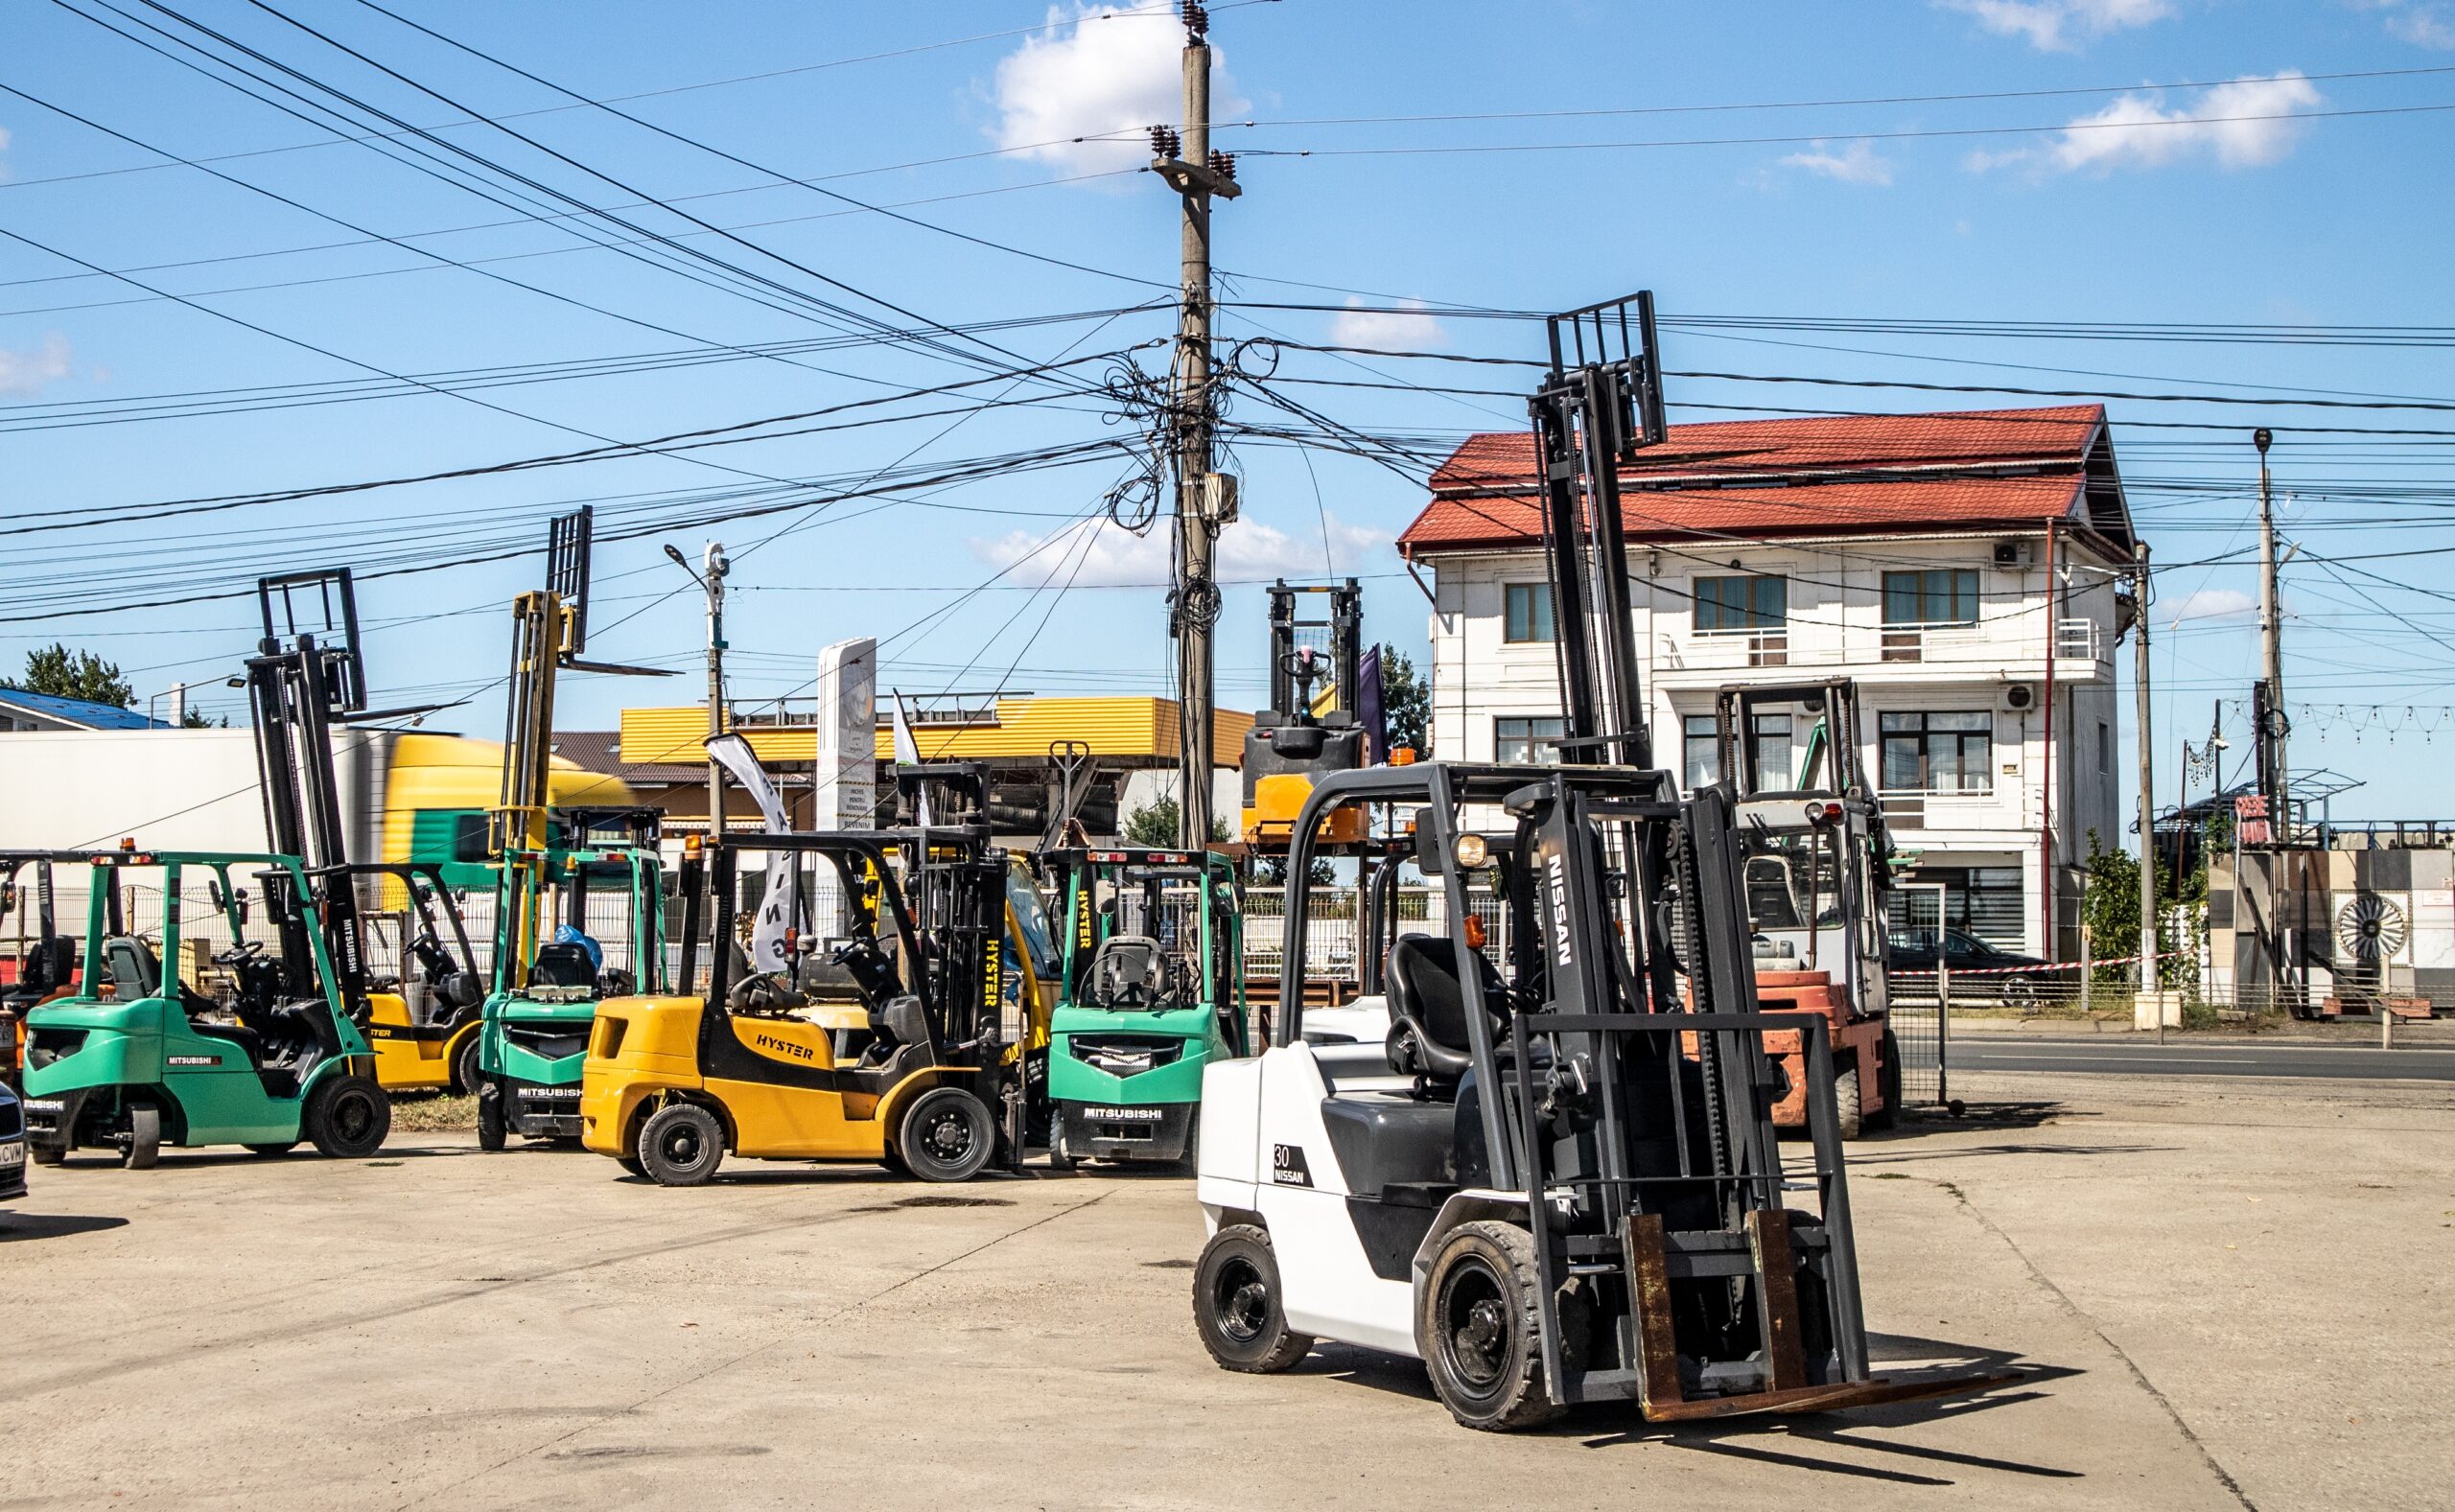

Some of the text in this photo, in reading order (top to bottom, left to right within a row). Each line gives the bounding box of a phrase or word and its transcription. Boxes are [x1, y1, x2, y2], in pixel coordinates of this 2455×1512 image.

[1078, 890, 1092, 949] HYSTER
[1548, 853, 1572, 966] NISSAN
[343, 919, 358, 973] MITSUBISHI
[984, 940, 999, 1008] HYSTER
[756, 1034, 814, 1060] HYSTER
[518, 1087, 584, 1097] MITSUBISH
[1084, 1107, 1162, 1119] MITSUBISHI
[1274, 1145, 1290, 1168] 30
[1274, 1169, 1304, 1184] NISSAN
